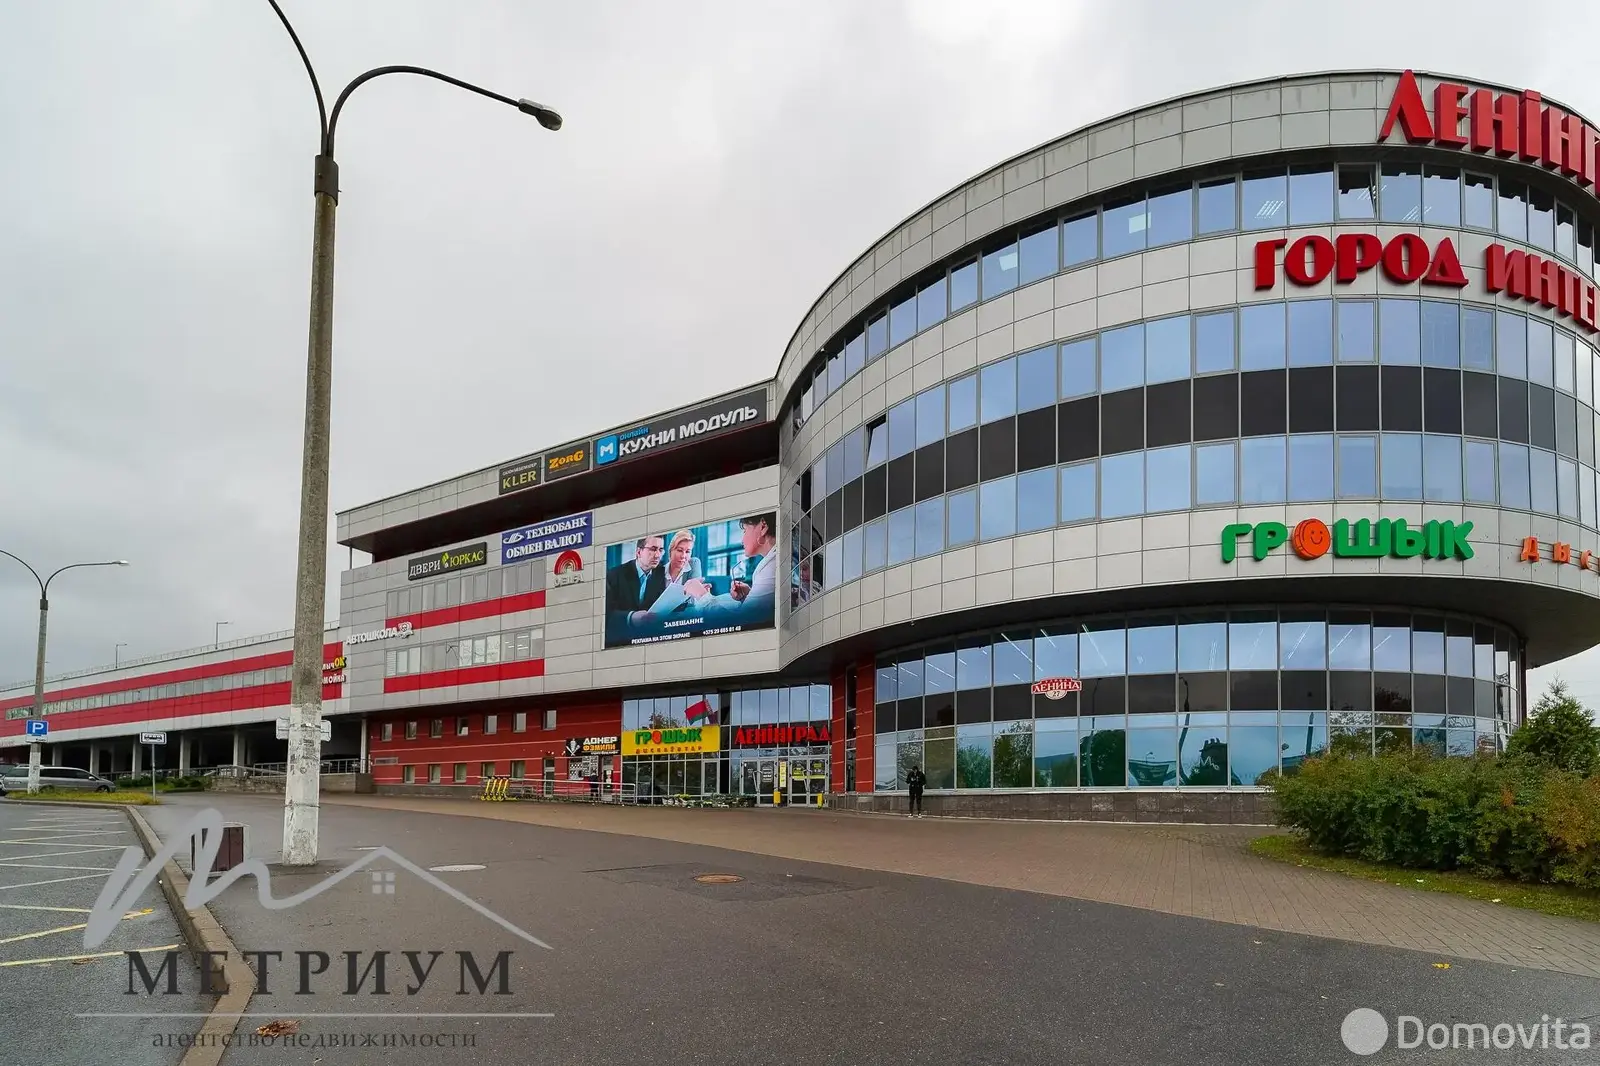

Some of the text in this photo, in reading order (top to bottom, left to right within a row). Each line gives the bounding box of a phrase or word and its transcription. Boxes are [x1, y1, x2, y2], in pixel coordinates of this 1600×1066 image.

[1377, 69, 1600, 199] ЛЕНІНГ
[1255, 233, 1600, 334] ГОРОД ИНТЕ
[619, 405, 758, 457] КУХНИ МОДУЛЬ
[503, 470, 537, 489] KLER
[525, 516, 588, 540] ТЕХНОБАНК
[506, 532, 585, 559] ОБМЕН ВАЛЮТ
[1221, 517, 1475, 563] ГРОШЫК
[409, 550, 484, 577] ДВЕРИ ЮРКАС
[346, 627, 398, 645] АВТОШКОЛА
[1034, 681, 1080, 693] ЛЕНИНА
[32, 722, 44, 733] P
[635, 728, 702, 745] ГРОШЫК
[735, 723, 831, 745] ЛЕНІНГРАД
[583, 736, 618, 745] ДОНЕР
[583, 743, 616, 751] ФЭМИЛИ
